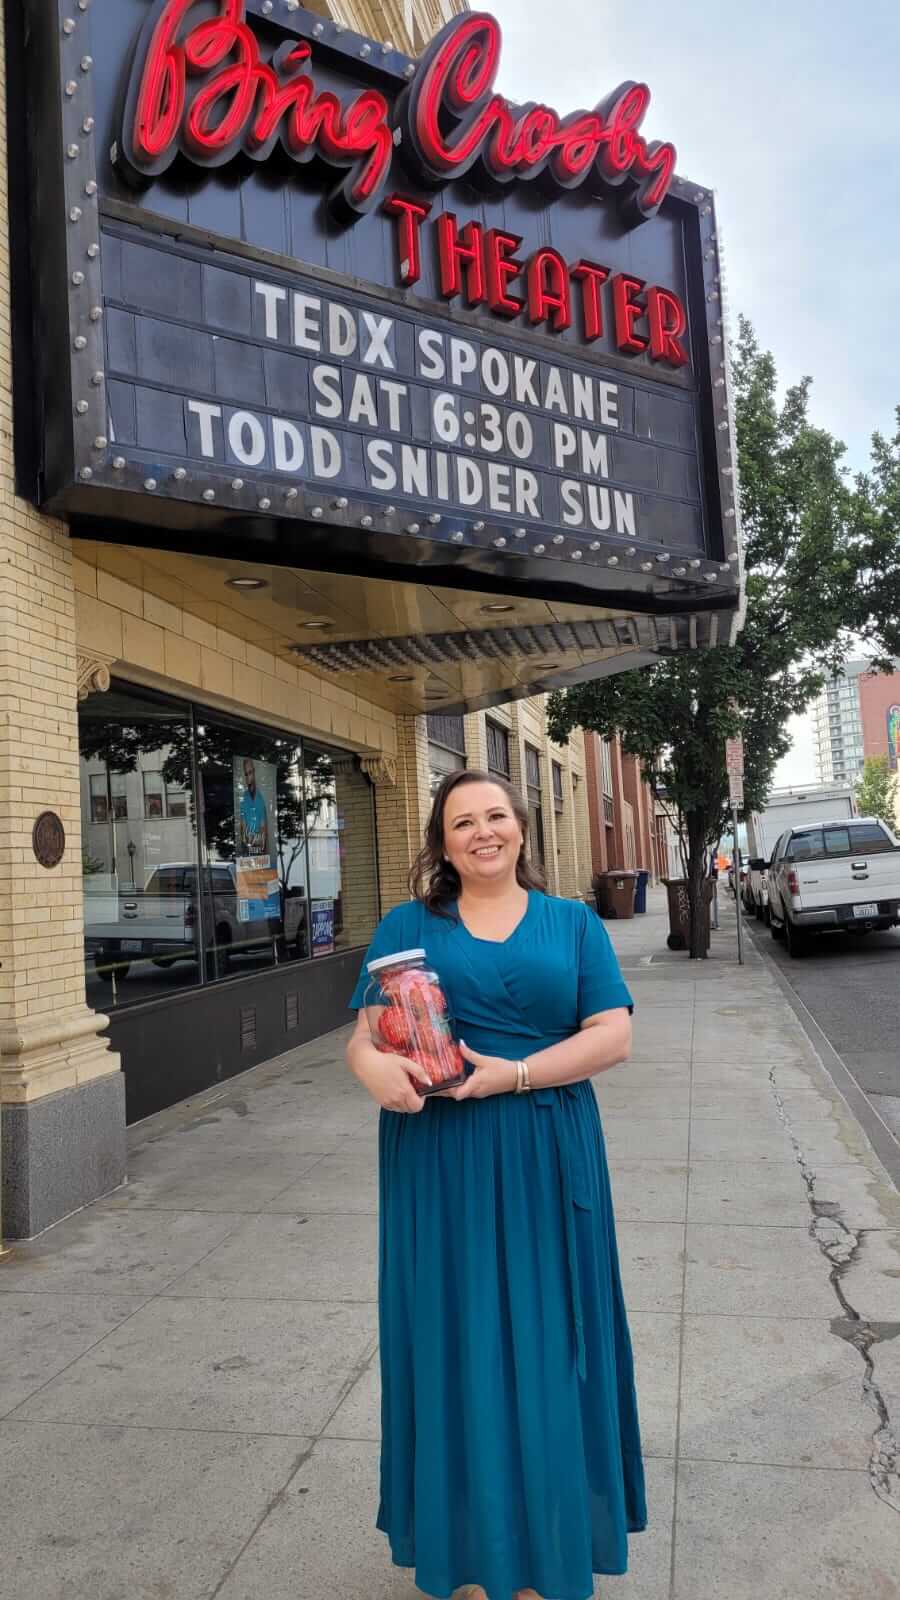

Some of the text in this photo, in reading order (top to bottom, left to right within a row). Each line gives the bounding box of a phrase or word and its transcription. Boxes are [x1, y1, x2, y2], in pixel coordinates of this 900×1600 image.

[134, 0, 677, 208] Bing Crosby
[254, 281, 620, 428] TEDX SPOKANE
[384, 193, 688, 369] THEATER
[188, 401, 637, 537] TODD SNIDER SUN
[312, 365, 609, 479] SAT 6:30 PM
